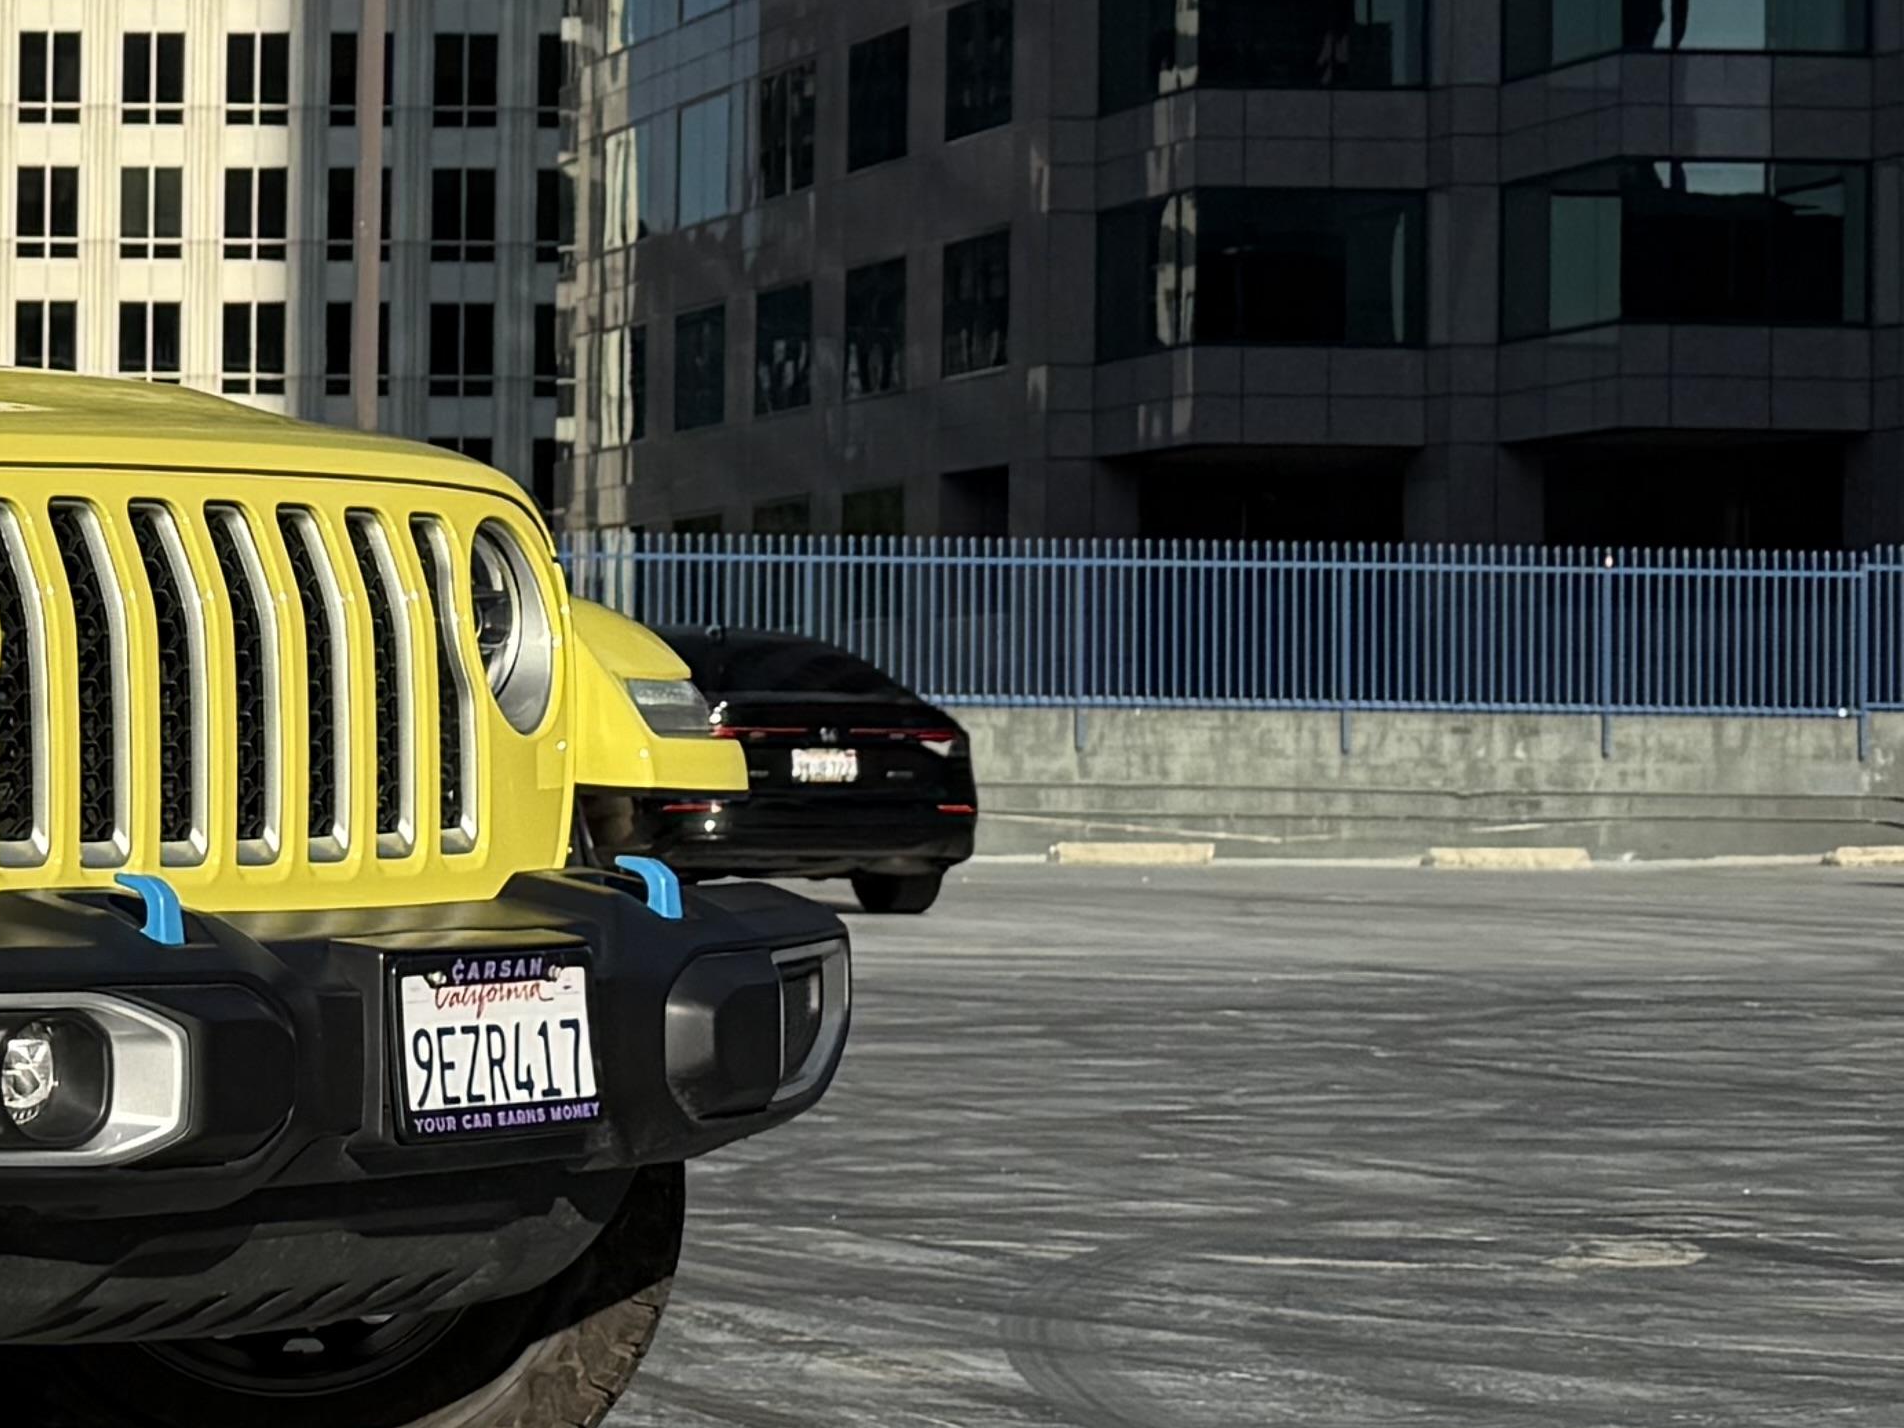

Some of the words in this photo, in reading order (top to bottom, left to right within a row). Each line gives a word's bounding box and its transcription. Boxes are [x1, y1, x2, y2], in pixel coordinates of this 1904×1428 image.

[434, 982, 554, 1018] California
[412, 1018, 582, 1108] 9EZR417
[413, 1116, 457, 1134] YOUR
[462, 1111, 492, 1129] CAR
[498, 1107, 546, 1127] EARNS
[550, 1101, 600, 1122] MONEY
